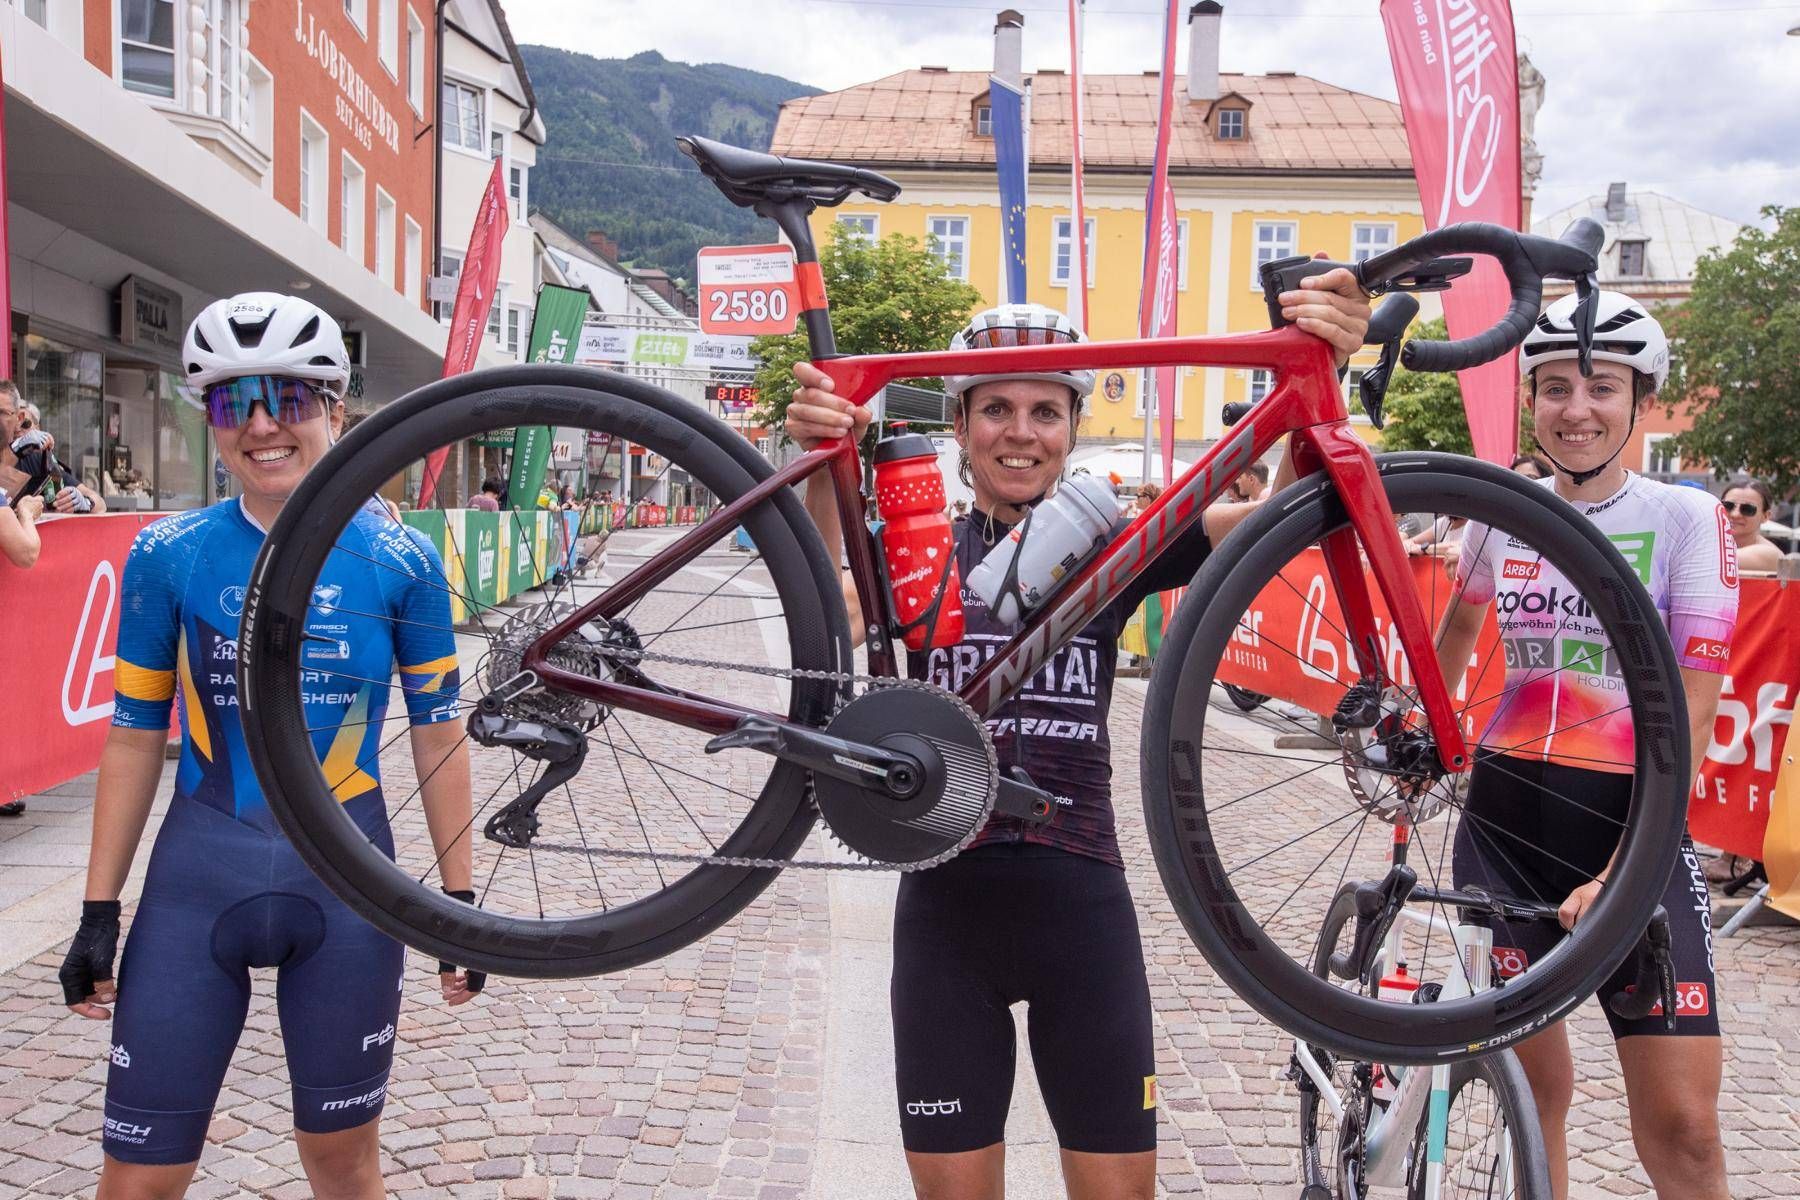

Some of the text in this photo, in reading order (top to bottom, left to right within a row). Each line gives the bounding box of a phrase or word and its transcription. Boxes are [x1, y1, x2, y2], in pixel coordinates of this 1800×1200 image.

[335, 94, 353, 130] SEIT
[710, 288, 788, 322] 2580
[519, 428, 536, 488] GUT BESSER
[143, 525, 180, 553] SPORT
[377, 532, 411, 556] SPORT
[988, 423, 1255, 718] MERIDA
[1504, 563, 1537, 577] ARBÖ
[243, 587, 261, 664] PIRELLI
[1234, 651, 1268, 671] BETTER
[984, 718, 1099, 742] ERIDA
[1512, 909, 1535, 917] GARMIN
[1490, 951, 1523, 973] BÖ
[1537, 1014, 1548, 1026] P
[1489, 1022, 1535, 1047] ZERO
